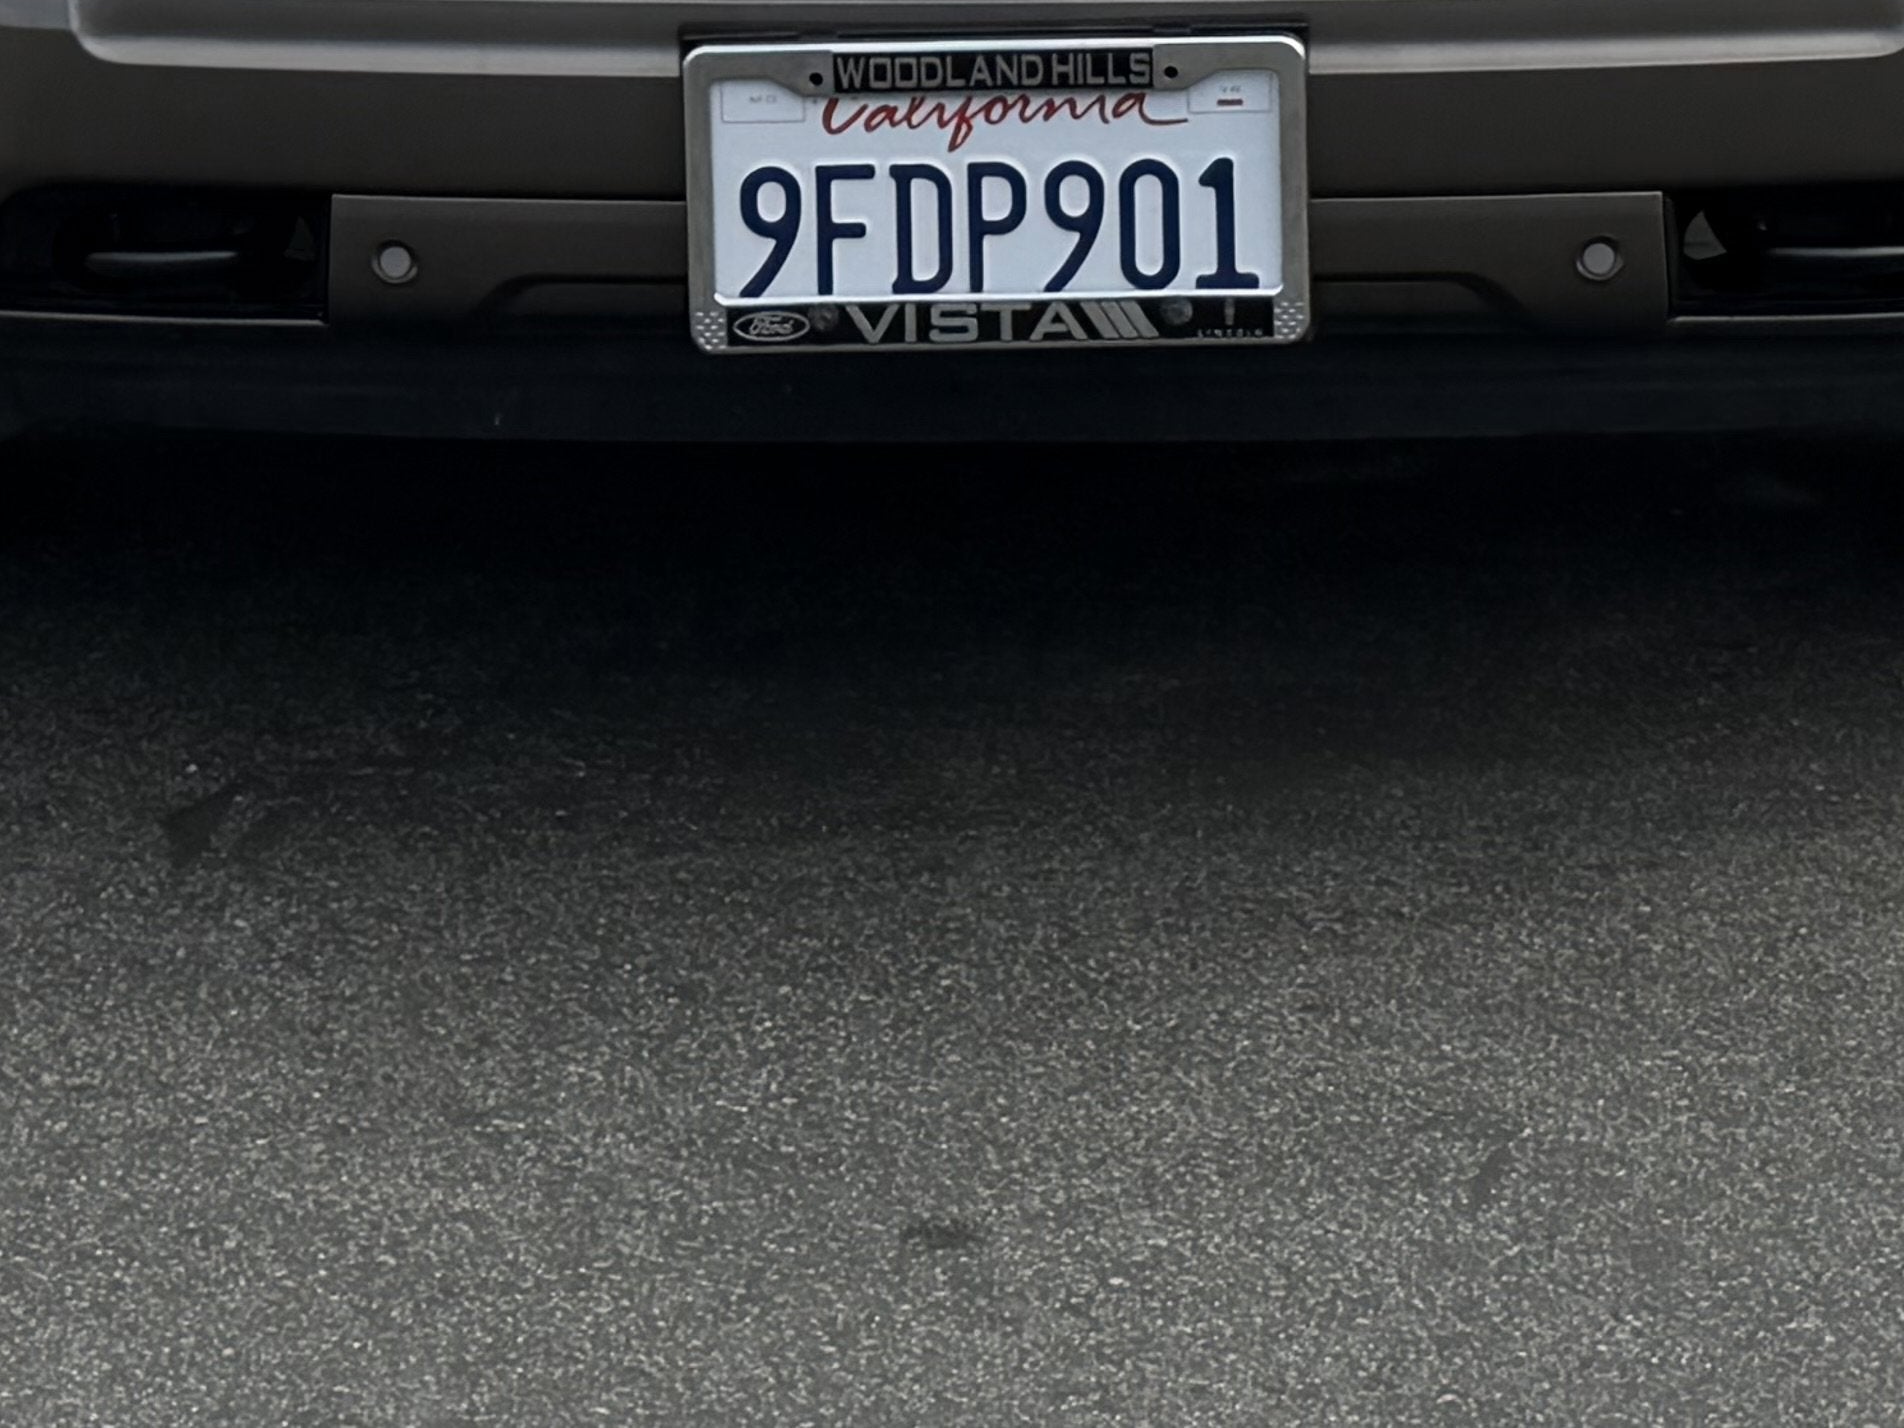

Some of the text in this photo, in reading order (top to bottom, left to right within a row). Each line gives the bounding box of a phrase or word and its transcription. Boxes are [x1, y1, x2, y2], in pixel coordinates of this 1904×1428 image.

[836, 51, 1152, 90] WOODLAND HILLS
[822, 91, 1189, 153] California
[739, 156, 1261, 299] 9FDP901
[845, 300, 1110, 343] VISTA
